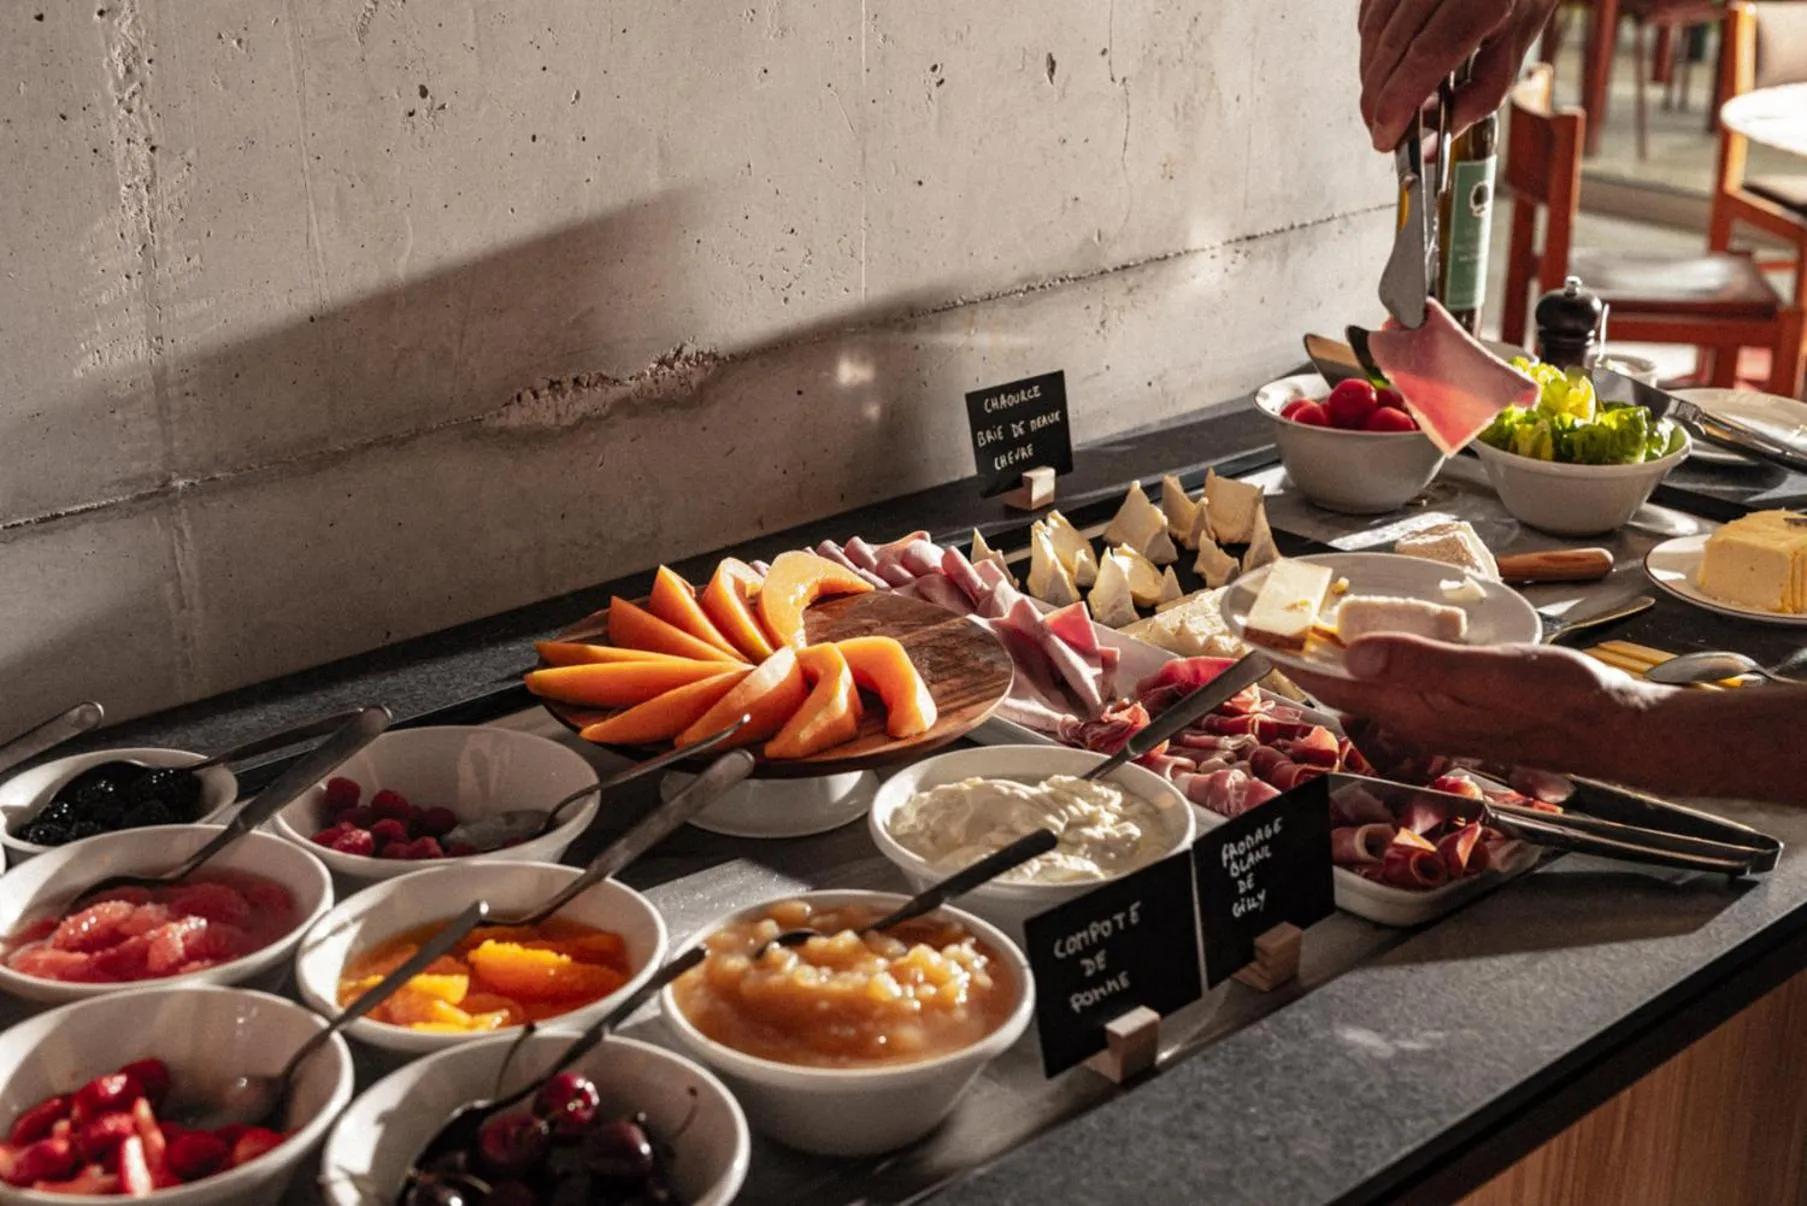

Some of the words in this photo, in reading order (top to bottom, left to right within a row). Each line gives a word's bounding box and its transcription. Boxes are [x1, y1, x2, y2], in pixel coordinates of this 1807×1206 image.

[983, 384, 1042, 414] CHAOURCE
[1010, 420, 1025, 438] DE
[1221, 816, 1283, 869] FROMAGE
[1237, 872, 1254, 895] DE
[1053, 900, 1142, 960] COMPOTE
[1080, 948, 1106, 977] DE
[1069, 970, 1130, 1014] POMME
